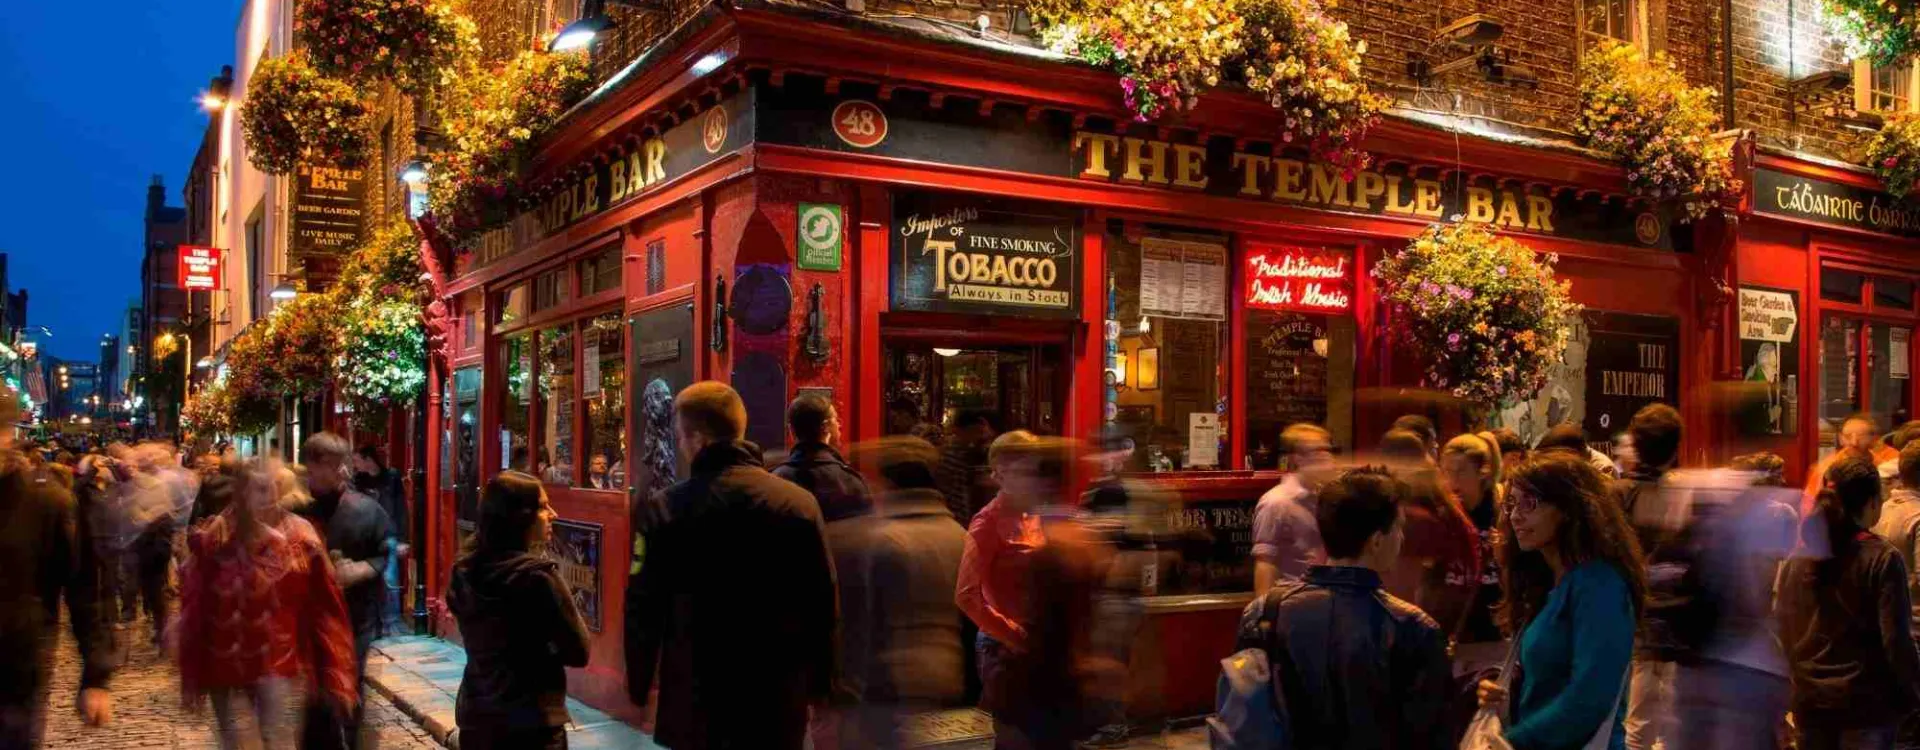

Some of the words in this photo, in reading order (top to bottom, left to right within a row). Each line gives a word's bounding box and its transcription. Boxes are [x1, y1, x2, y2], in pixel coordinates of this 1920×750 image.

[707, 115, 723, 143] 48
[841, 107, 875, 136] 48
[610, 138, 665, 201] BAR
[311, 175, 348, 191] BAR
[1076, 131, 1209, 189] THE
[1232, 152, 1444, 217] TEMPLE
[1466, 186, 1553, 231] BAR
[298, 205, 321, 213] BEER
[323, 207, 361, 216] GARDEN
[901, 207, 979, 239] Importers
[950, 226, 964, 236] OF
[301, 230, 324, 238] LIVE
[326, 231, 355, 240] MUSIC
[315, 238, 342, 246] DAILY
[970, 235, 998, 250] FINE
[1001, 238, 1055, 253] SMOKING
[192, 249, 209, 257] THE
[1250, 255, 1344, 278] Traditional
[951, 285, 1001, 300] Always
[1010, 290, 1021, 300] in
[1028, 290, 1067, 304] Stock
[1249, 279, 1292, 304] Irish
[1300, 283, 1348, 308] Music
[1759, 295, 1785, 311] Garden
[1747, 323, 1764, 337] Area
[1638, 344, 1665, 369] THE
[1603, 370, 1664, 398] EMPEROR
